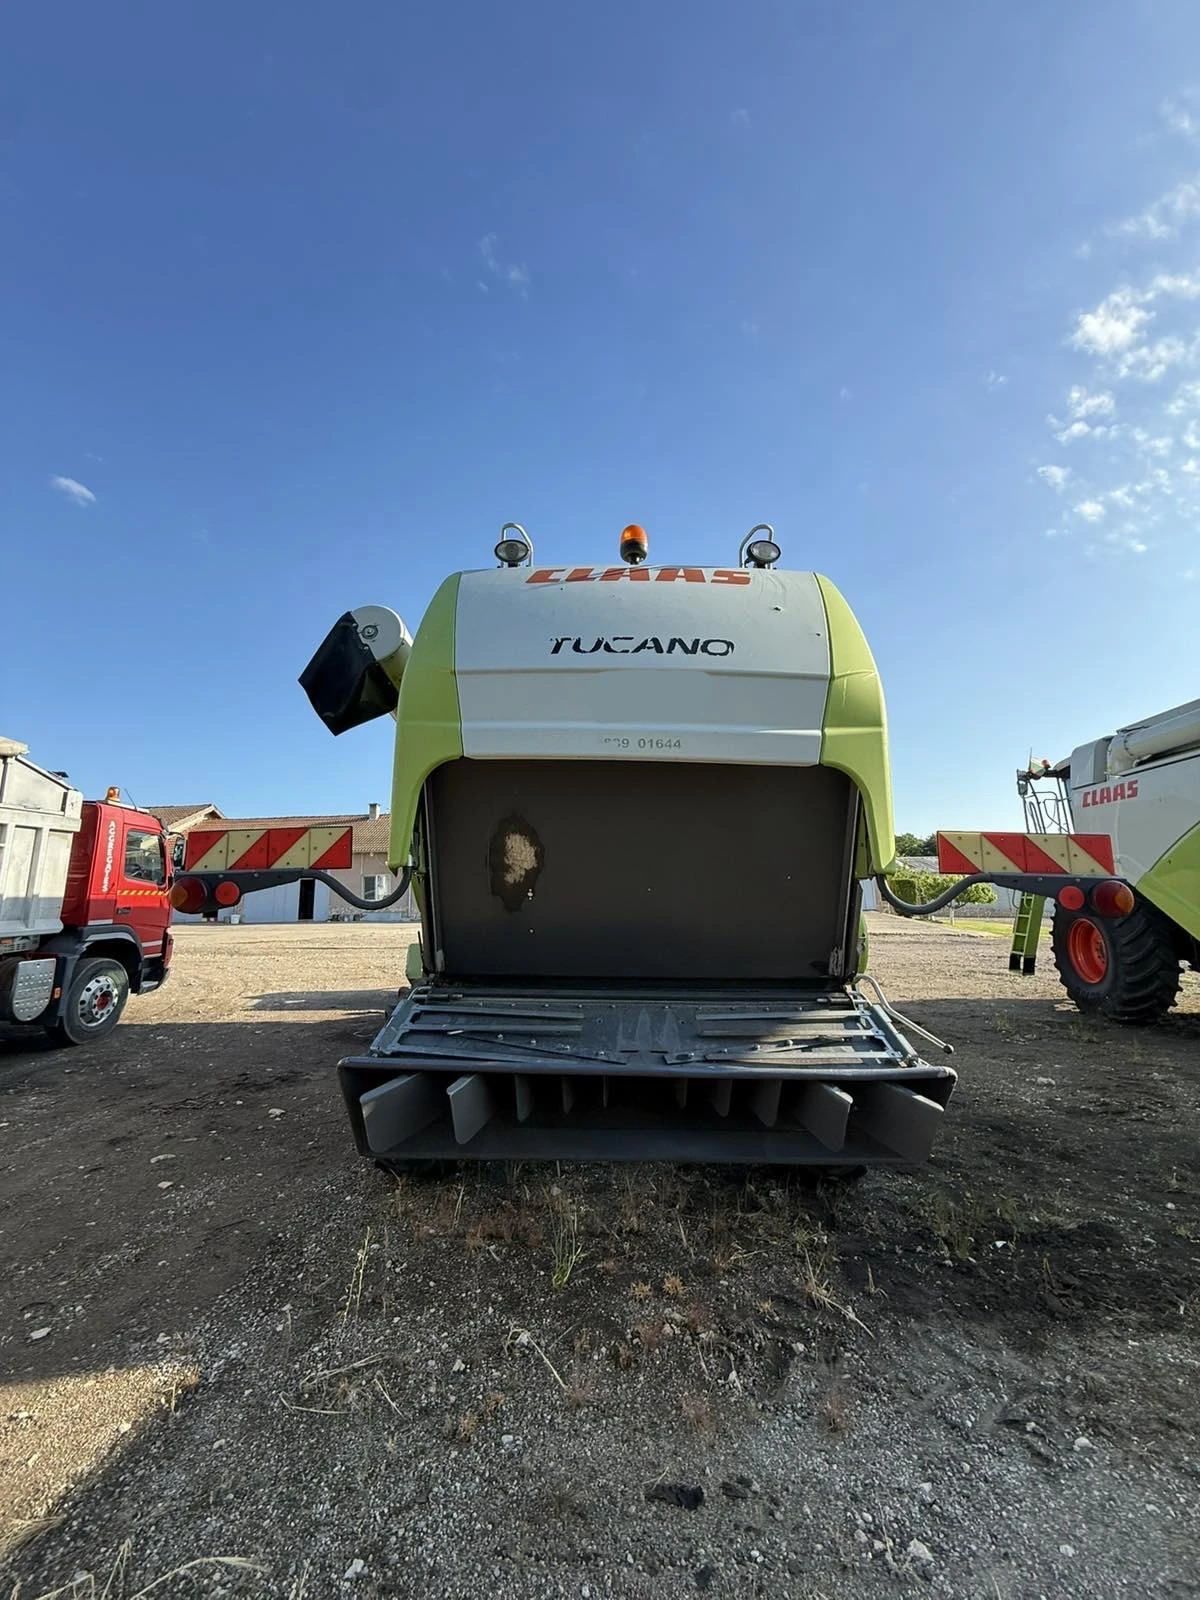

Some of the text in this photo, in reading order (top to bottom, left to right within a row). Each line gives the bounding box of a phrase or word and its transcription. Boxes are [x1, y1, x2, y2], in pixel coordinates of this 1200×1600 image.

[526, 567, 751, 585] CLAAS
[550, 636, 735, 657] TUCANO
[638, 738, 681, 749] 01644
[1082, 780, 1138, 808] CLAAS
